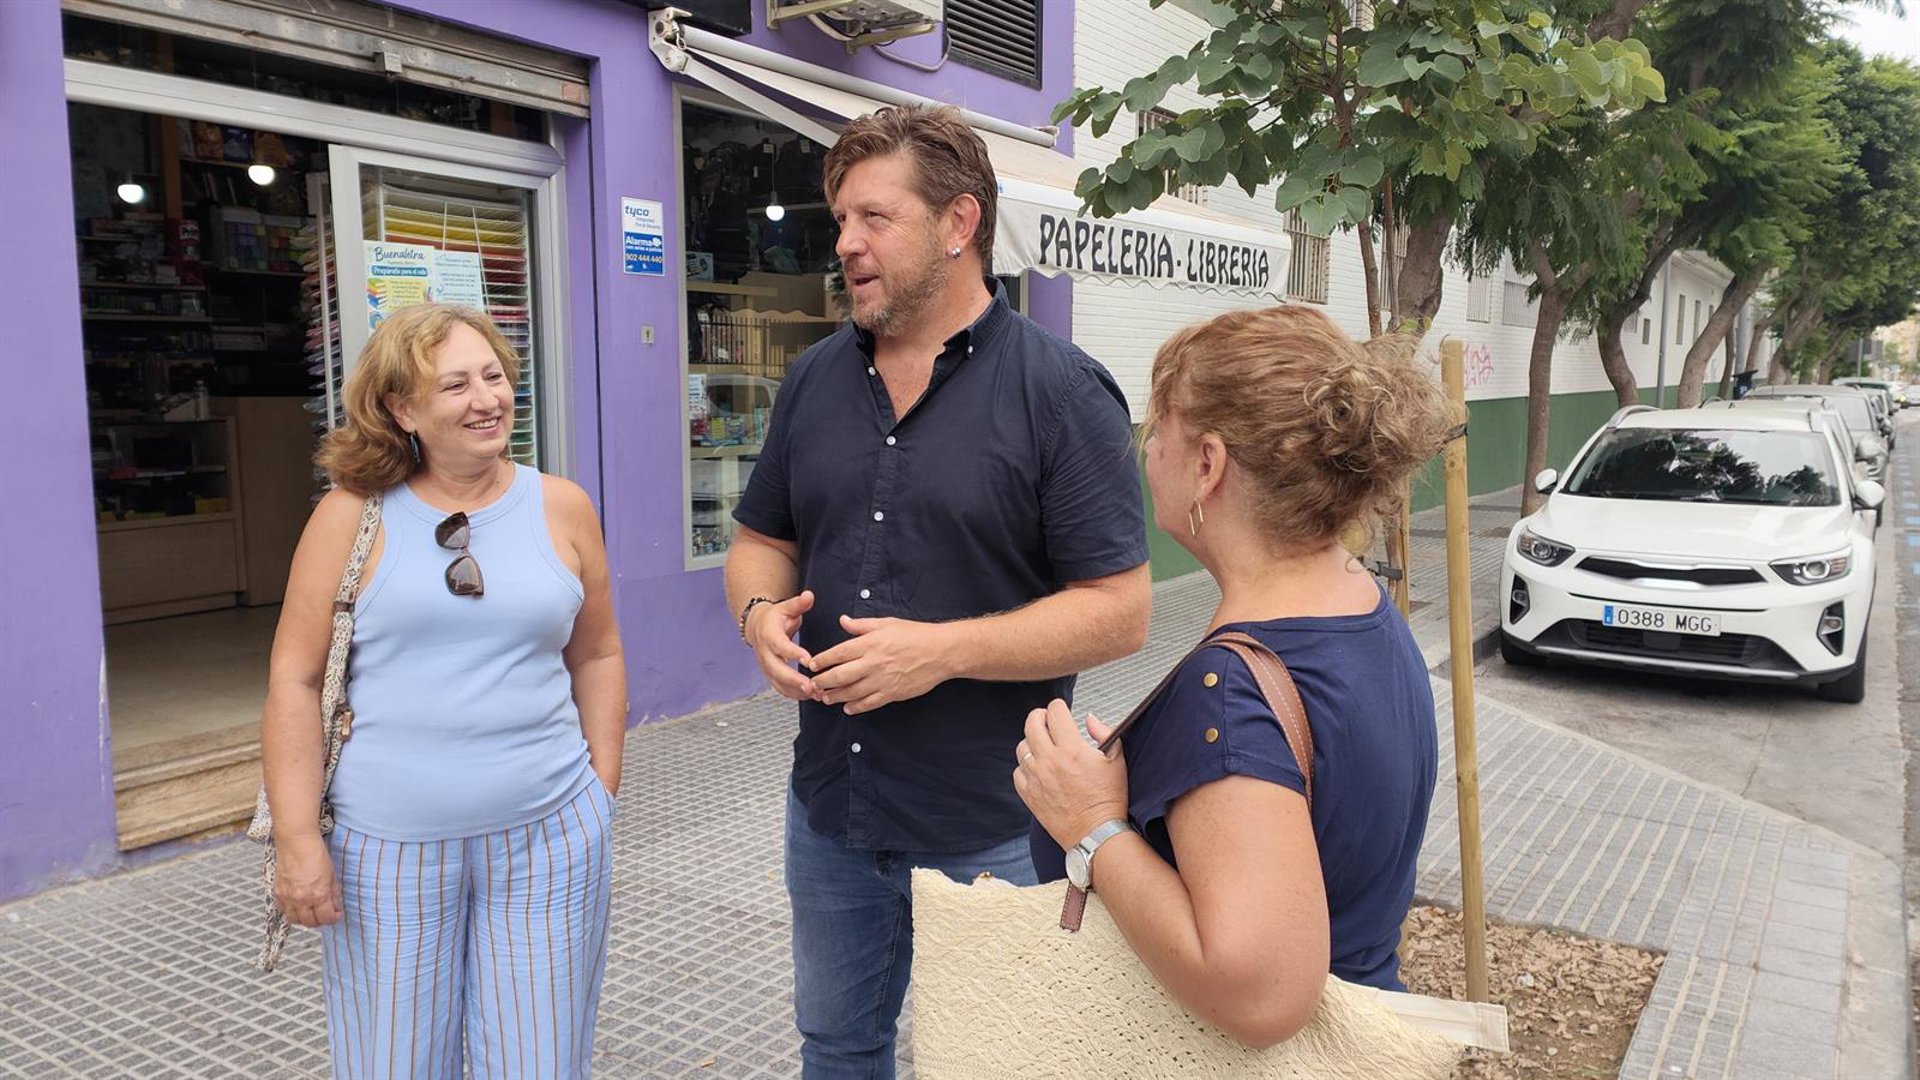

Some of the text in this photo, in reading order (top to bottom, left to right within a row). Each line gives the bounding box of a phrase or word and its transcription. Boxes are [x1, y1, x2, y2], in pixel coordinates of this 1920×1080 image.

[625, 205, 649, 217] tyco
[1039, 214, 1269, 288] PAPELERIA LIBRERIA
[1618, 609, 1712, 633] 0388 MGG
